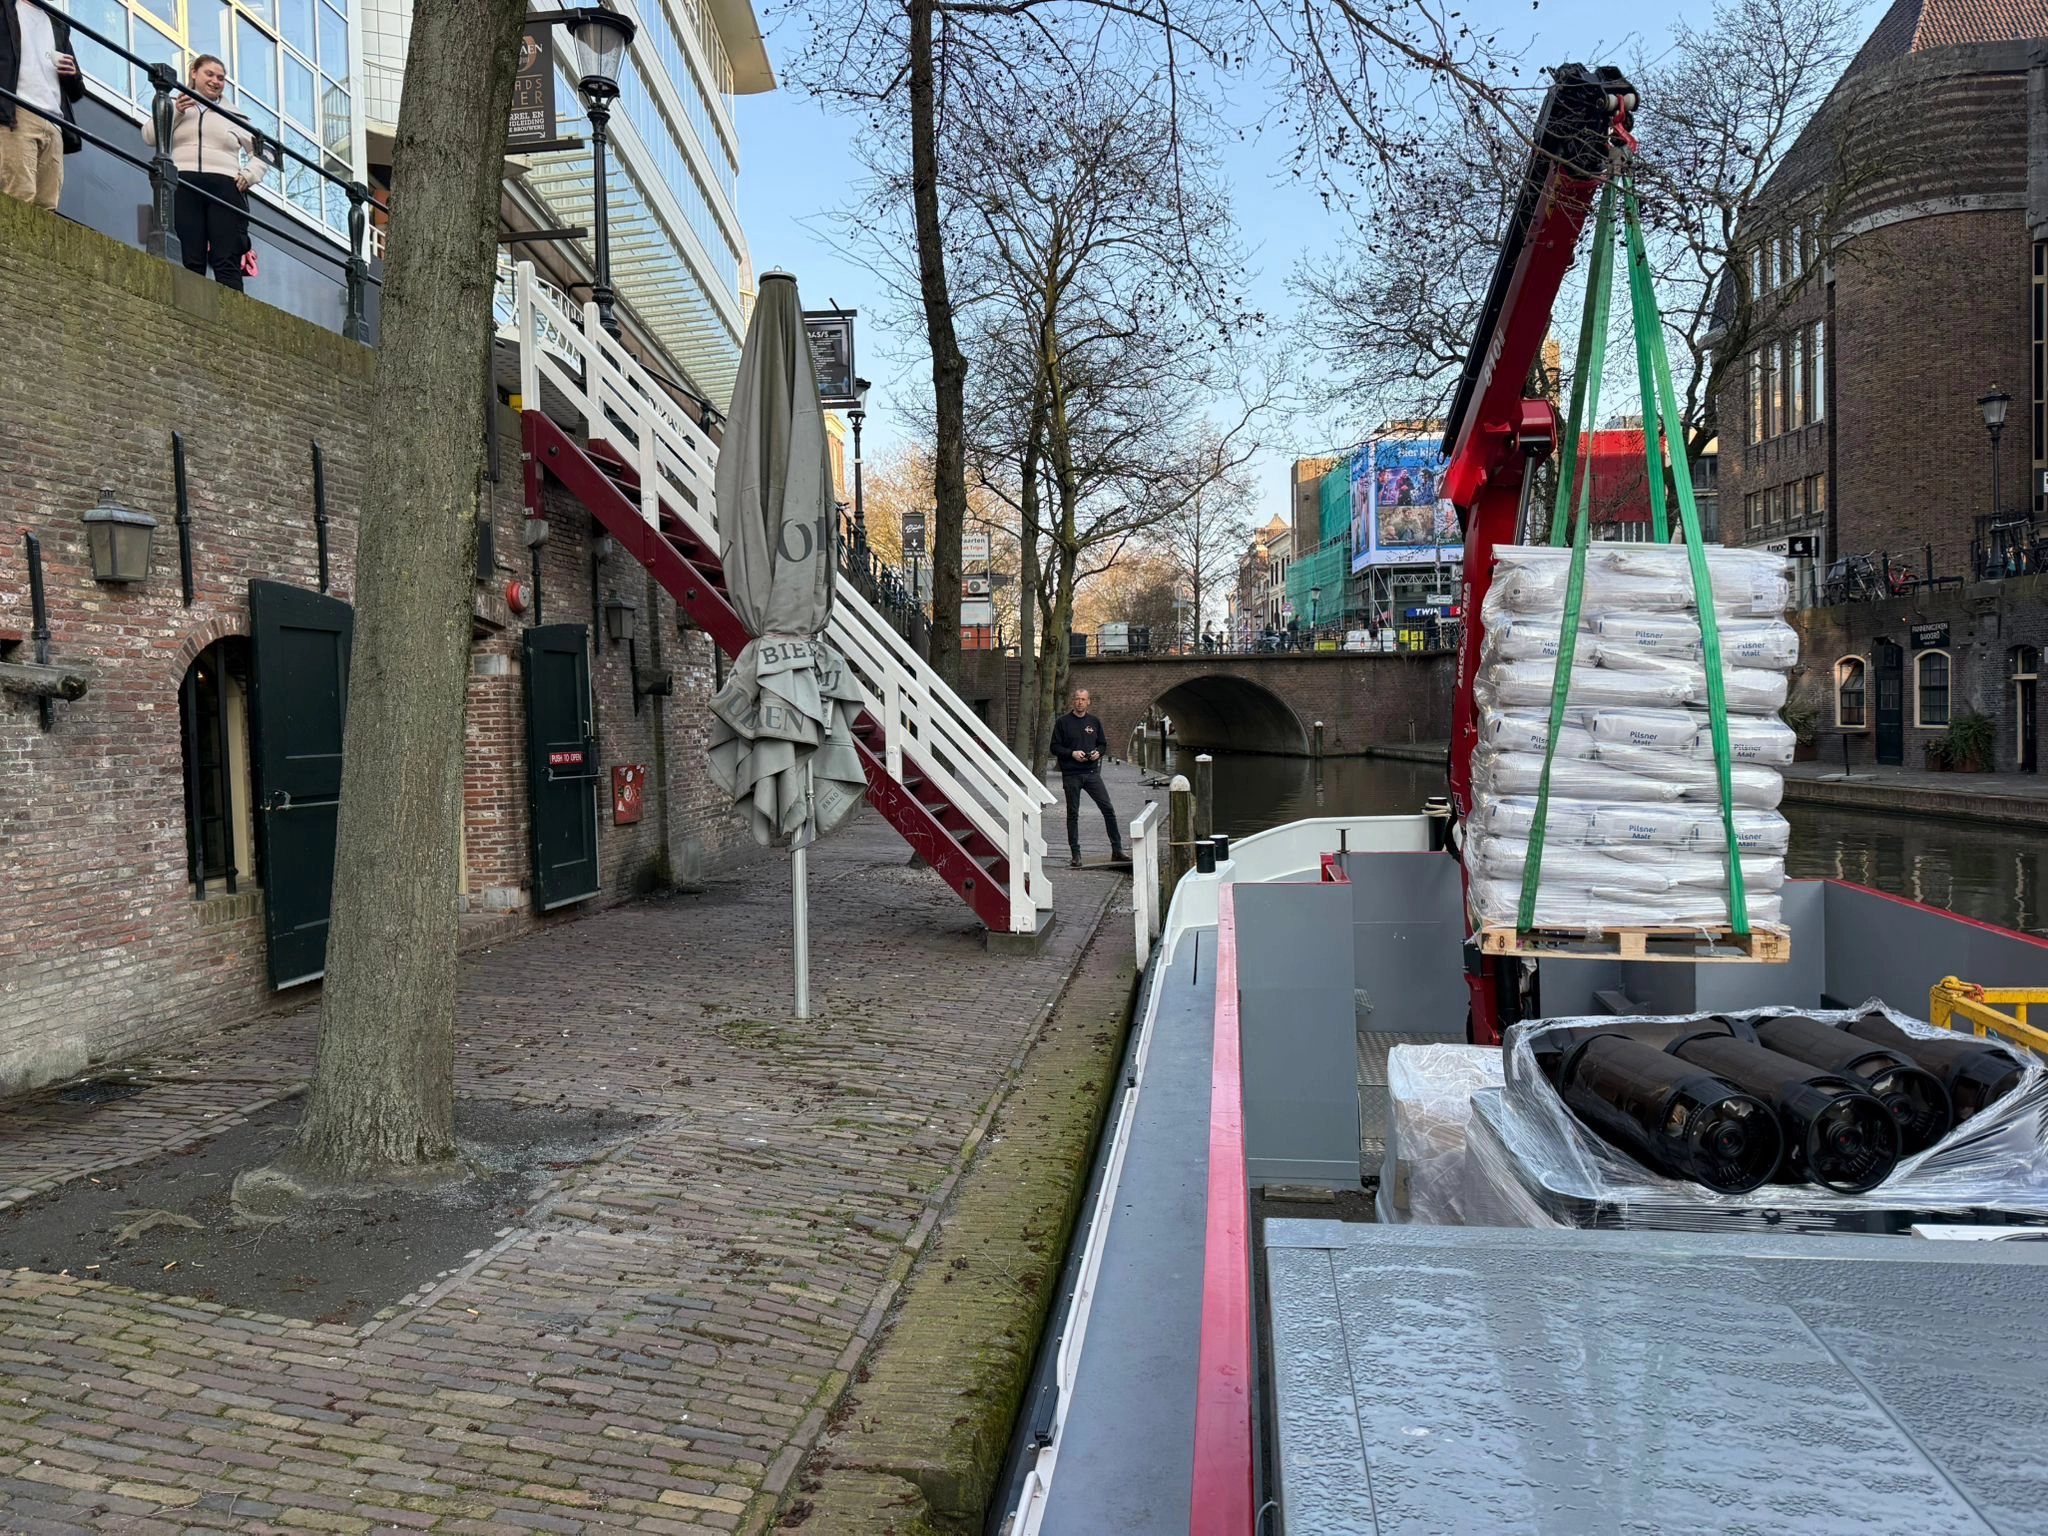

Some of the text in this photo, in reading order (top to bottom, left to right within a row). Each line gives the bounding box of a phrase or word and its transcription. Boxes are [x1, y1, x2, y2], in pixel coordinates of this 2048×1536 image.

[515, 79, 542, 91] ADS
[532, 111, 544, 119] EN
[1635, 631, 1663, 639] Pilsner
[1542, 648, 1558, 656] Mal
[1630, 730, 1658, 740] Pilsner
[1734, 744, 1762, 752] Pilsner
[551, 754, 562, 762] PUSH
[570, 753, 582, 762] OPEN
[1629, 824, 1657, 834] Pilsner
[1500, 936, 1505, 948] 8
